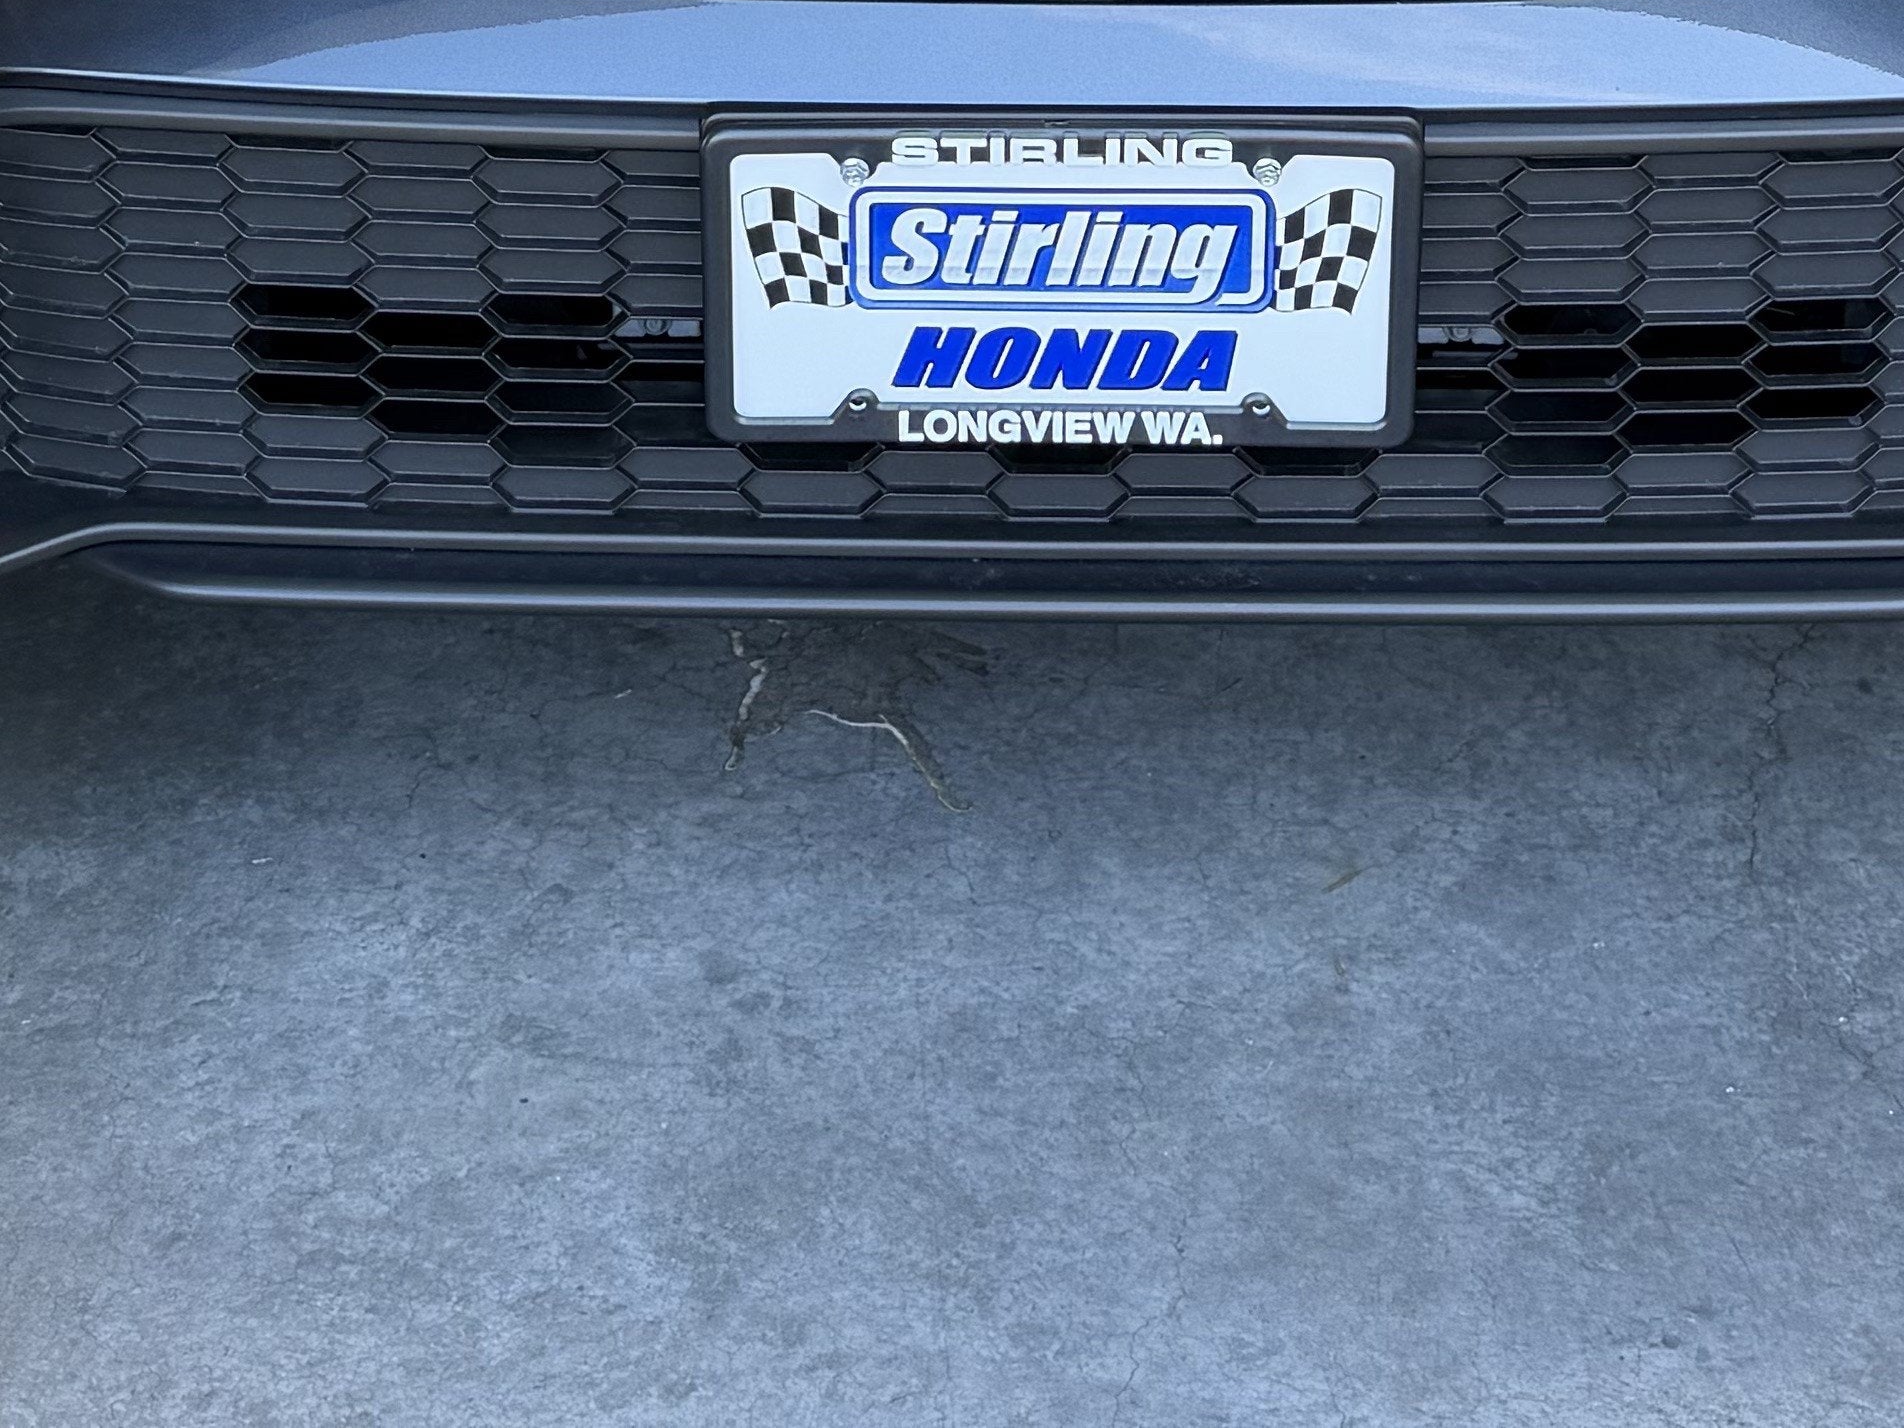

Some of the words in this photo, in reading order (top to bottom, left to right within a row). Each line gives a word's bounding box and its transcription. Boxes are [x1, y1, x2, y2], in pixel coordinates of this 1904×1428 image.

[890, 134, 1234, 167] STIRLING
[881, 207, 1239, 305] Stirling
[891, 325, 1239, 393] HONDA
[897, 410, 1133, 444] LONGVIEW
[1138, 411, 1224, 446] WA.
